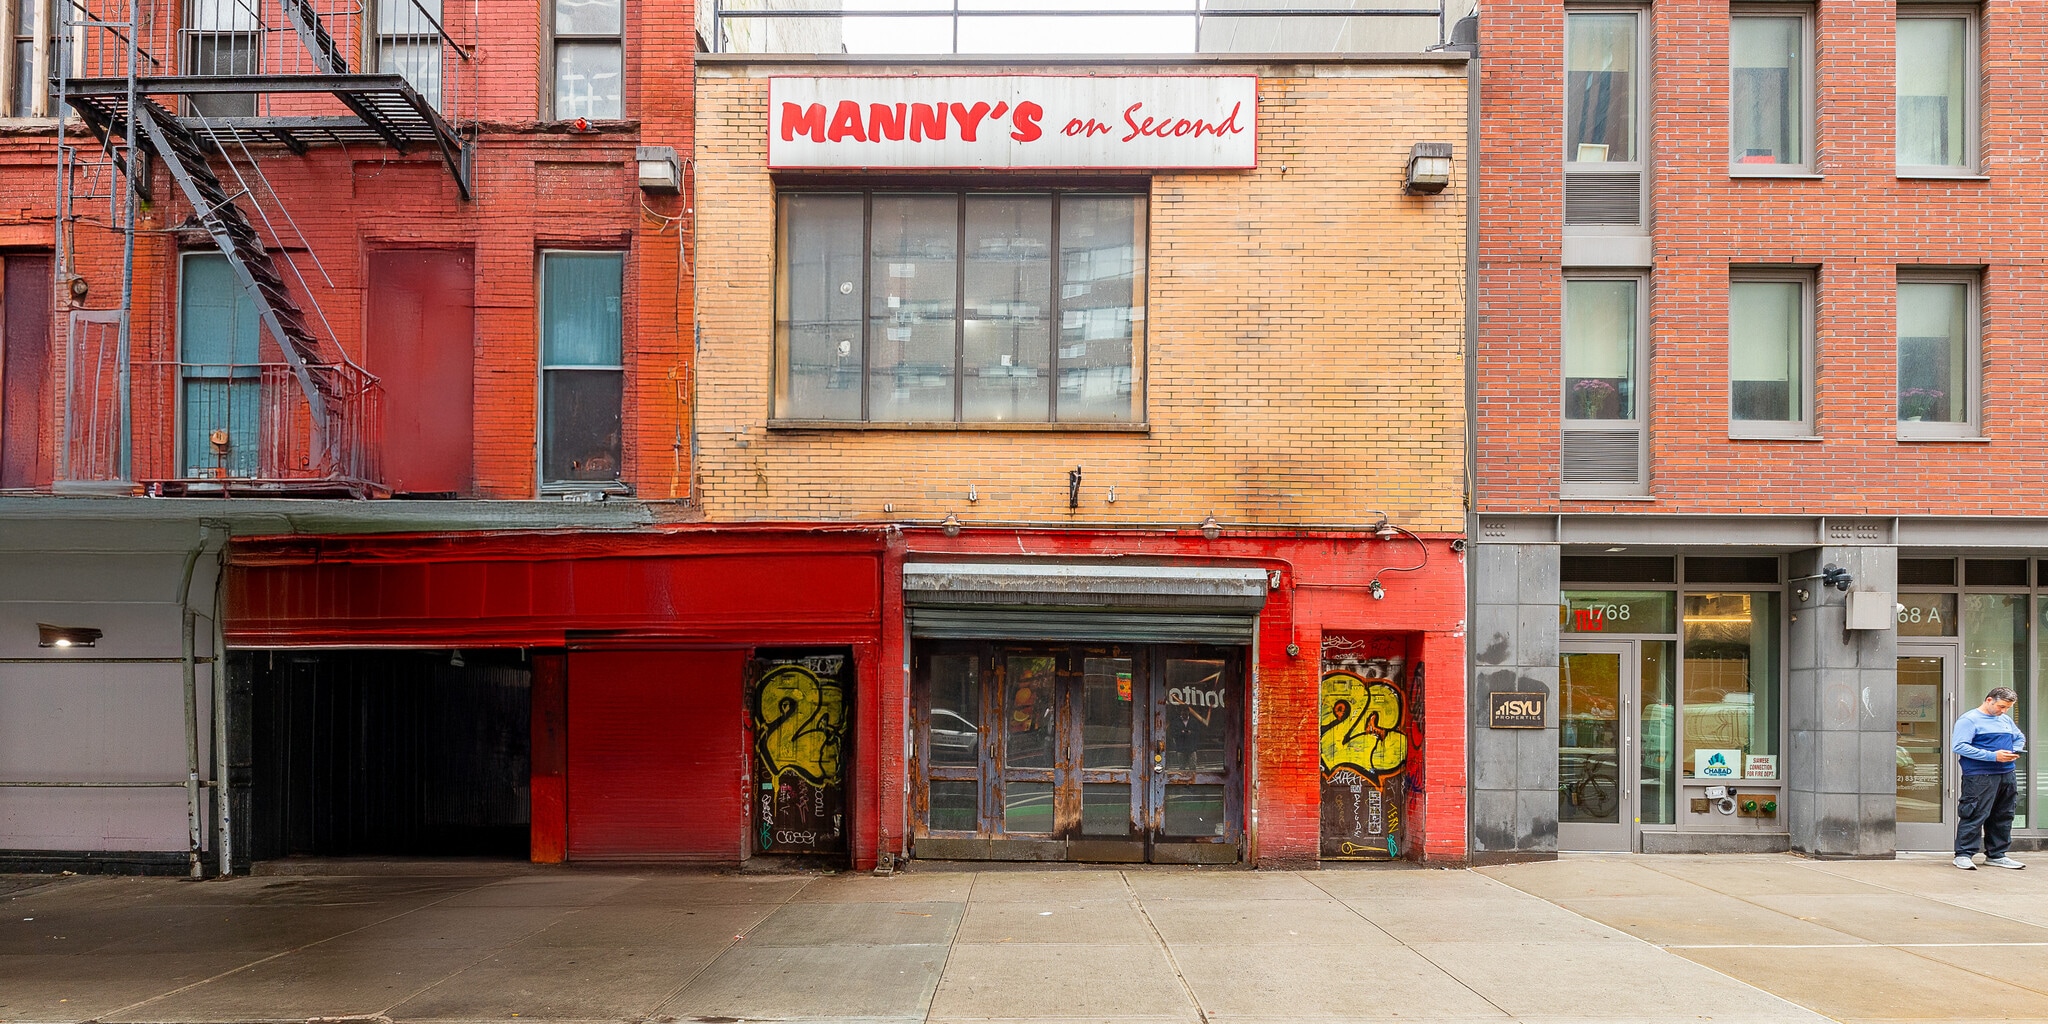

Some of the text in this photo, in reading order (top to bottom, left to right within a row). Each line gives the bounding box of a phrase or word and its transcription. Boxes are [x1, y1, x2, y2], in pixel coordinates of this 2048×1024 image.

[780, 100, 1245, 143] MANNY'S on Second
[1587, 604, 1630, 620] 1768
[1927, 607, 1941, 623] A
